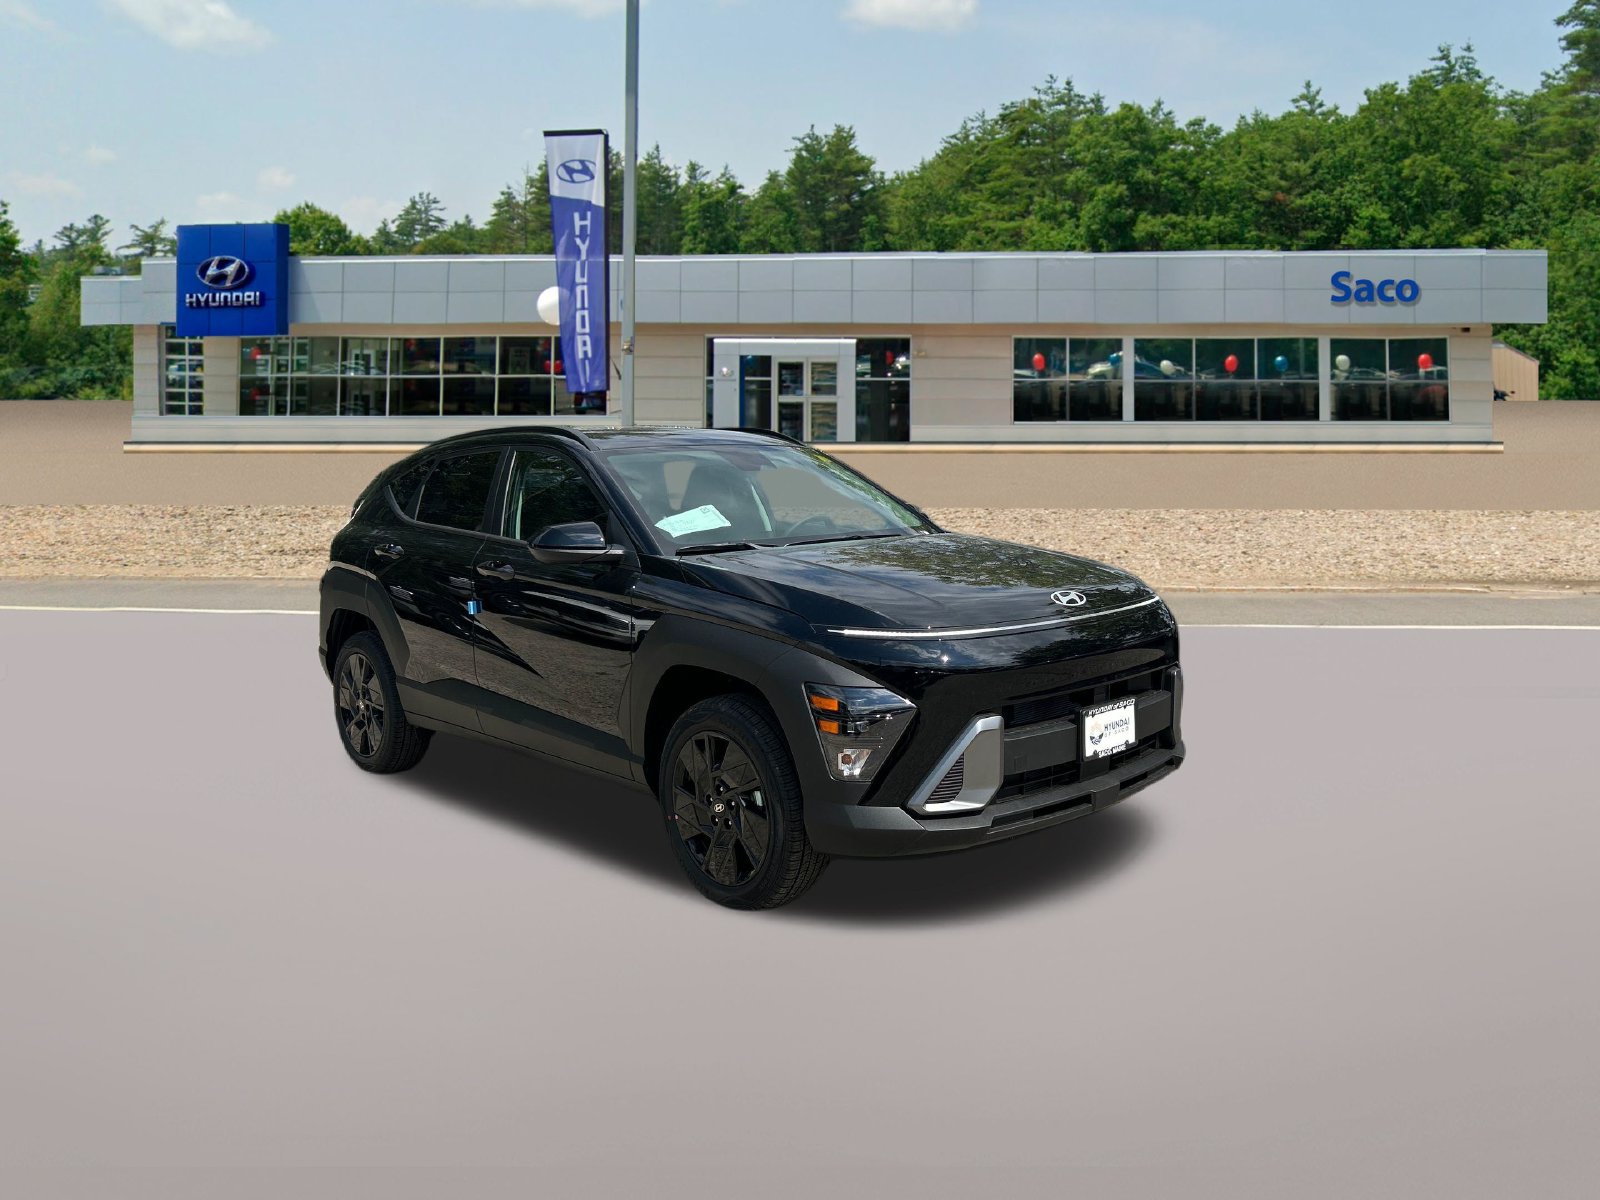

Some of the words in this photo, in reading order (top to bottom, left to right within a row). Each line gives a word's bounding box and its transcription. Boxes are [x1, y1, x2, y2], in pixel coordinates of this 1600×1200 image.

[573, 211, 592, 384] HYUNDAI
[1330, 270, 1420, 302] Saco
[185, 291, 260, 307] HYUNDAI
[1104, 717, 1129, 731] HYUNDAI
